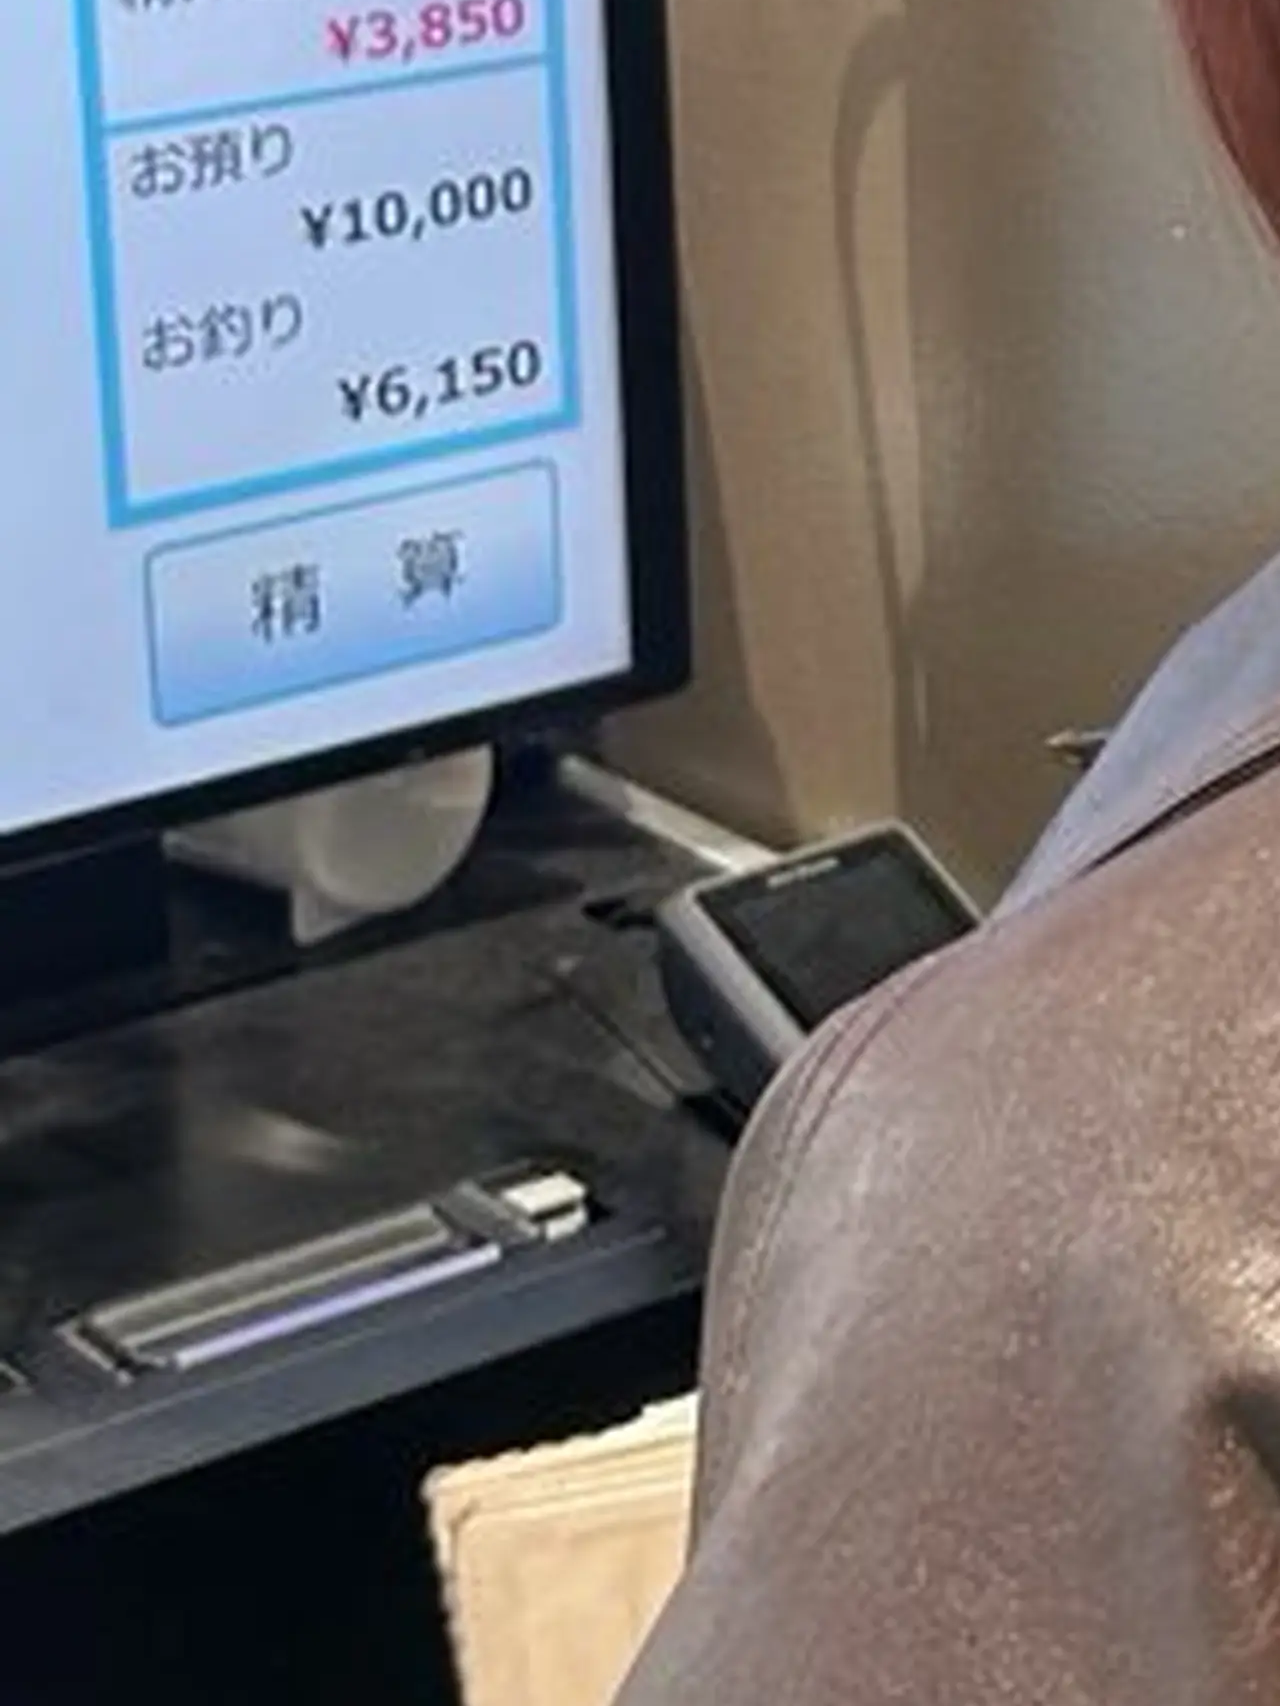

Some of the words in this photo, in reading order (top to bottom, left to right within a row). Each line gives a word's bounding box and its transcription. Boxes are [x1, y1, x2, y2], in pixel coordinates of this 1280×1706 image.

[130, 121, 294, 199] お預り
[301, 166, 533, 248] ¥10,000
[142, 292, 303, 371] お釣り
[338, 339, 542, 421] ¥6,150
